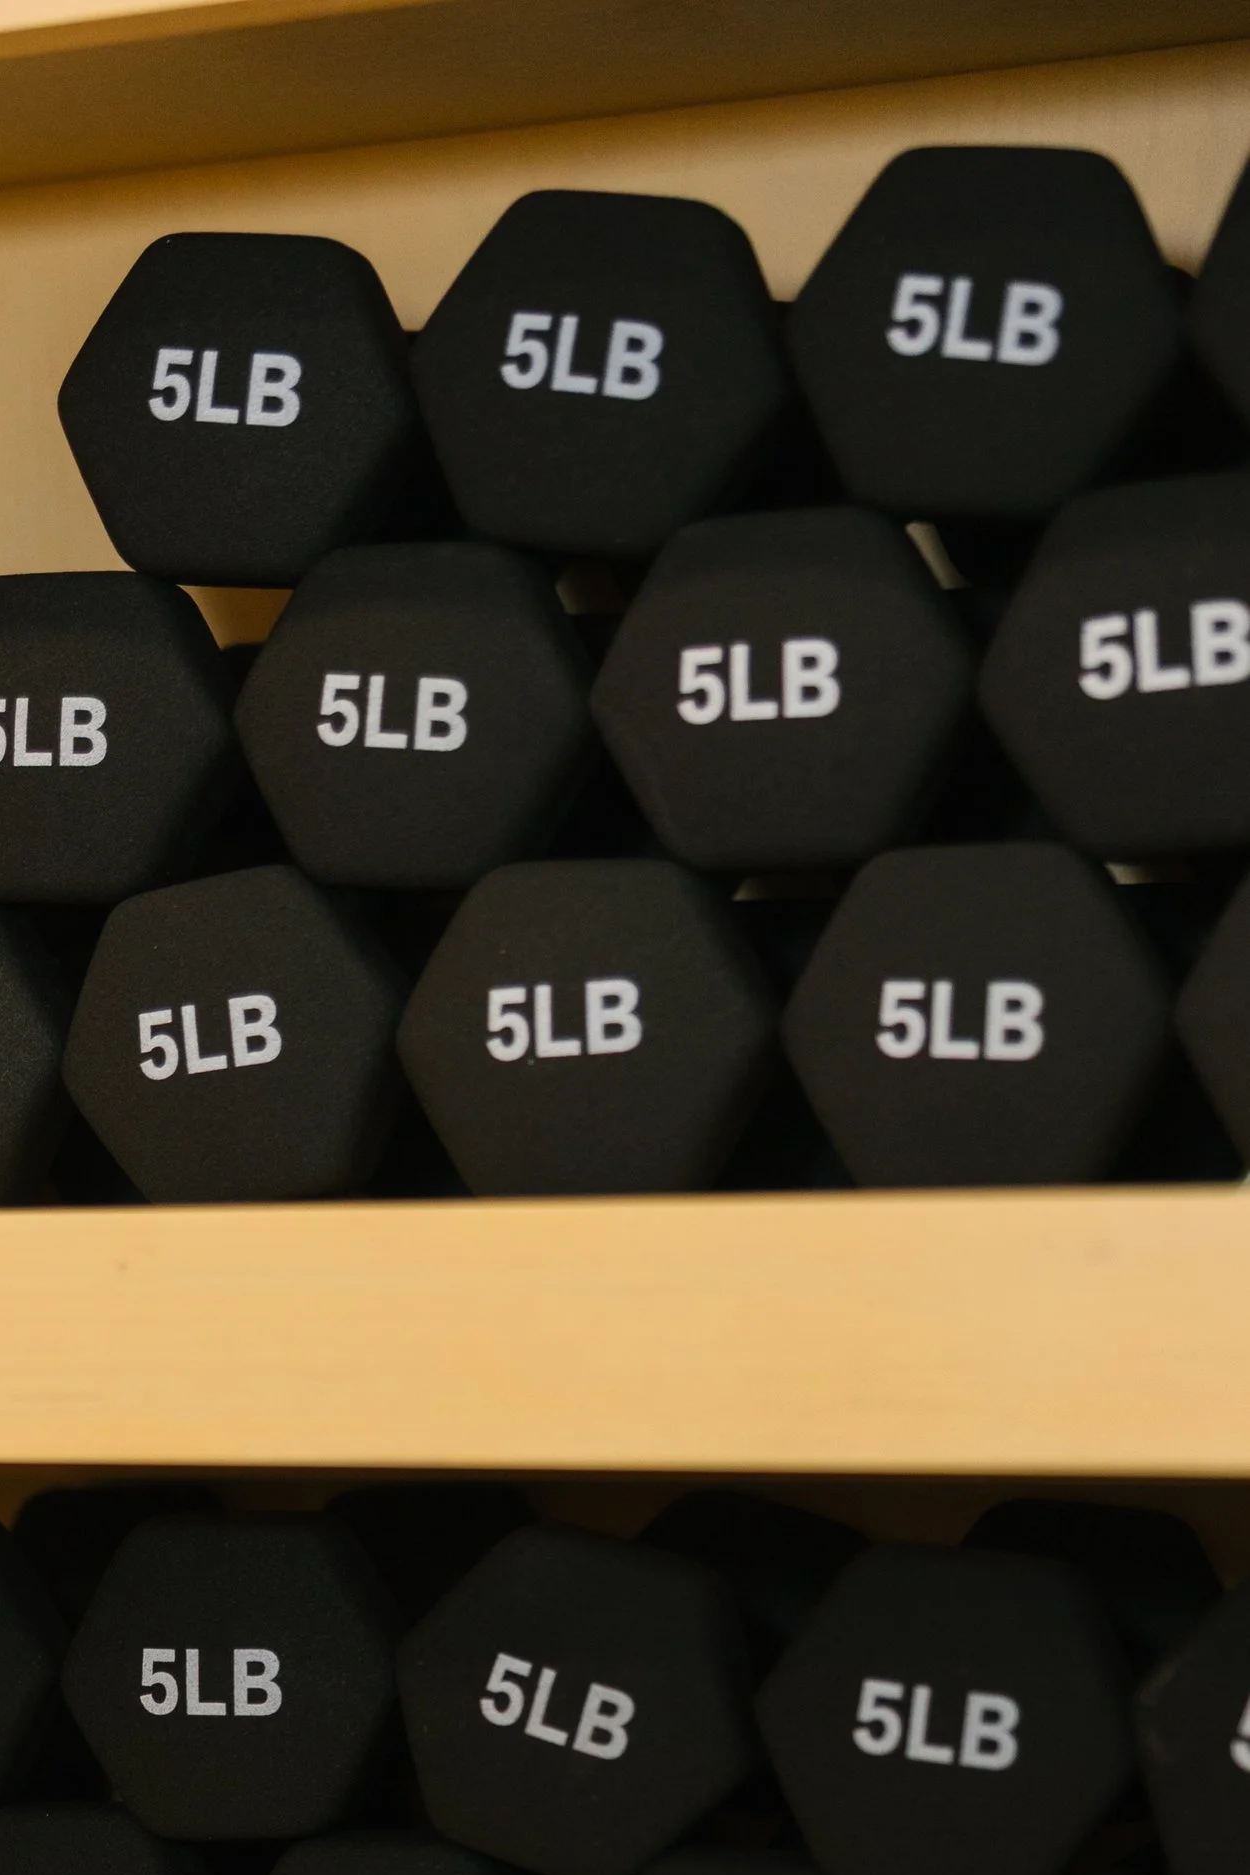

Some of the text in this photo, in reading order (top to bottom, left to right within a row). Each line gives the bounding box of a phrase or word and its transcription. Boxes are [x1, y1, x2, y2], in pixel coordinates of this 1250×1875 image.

[499, 311, 664, 401] 5LB
[886, 273, 1063, 366] 5LB
[147, 347, 303, 428] 5LB
[676, 637, 842, 726] 5LB
[1078, 599, 1250, 701] 5LB
[315, 672, 469, 753] 5LB
[137, 993, 284, 1082] 5LB
[485, 977, 644, 1063] 5LB
[875, 979, 1045, 1062] 5LB
[138, 1647, 284, 1717] 5LB
[479, 1652, 636, 1761] 5LB
[852, 1678, 1020, 1771] 5LB
